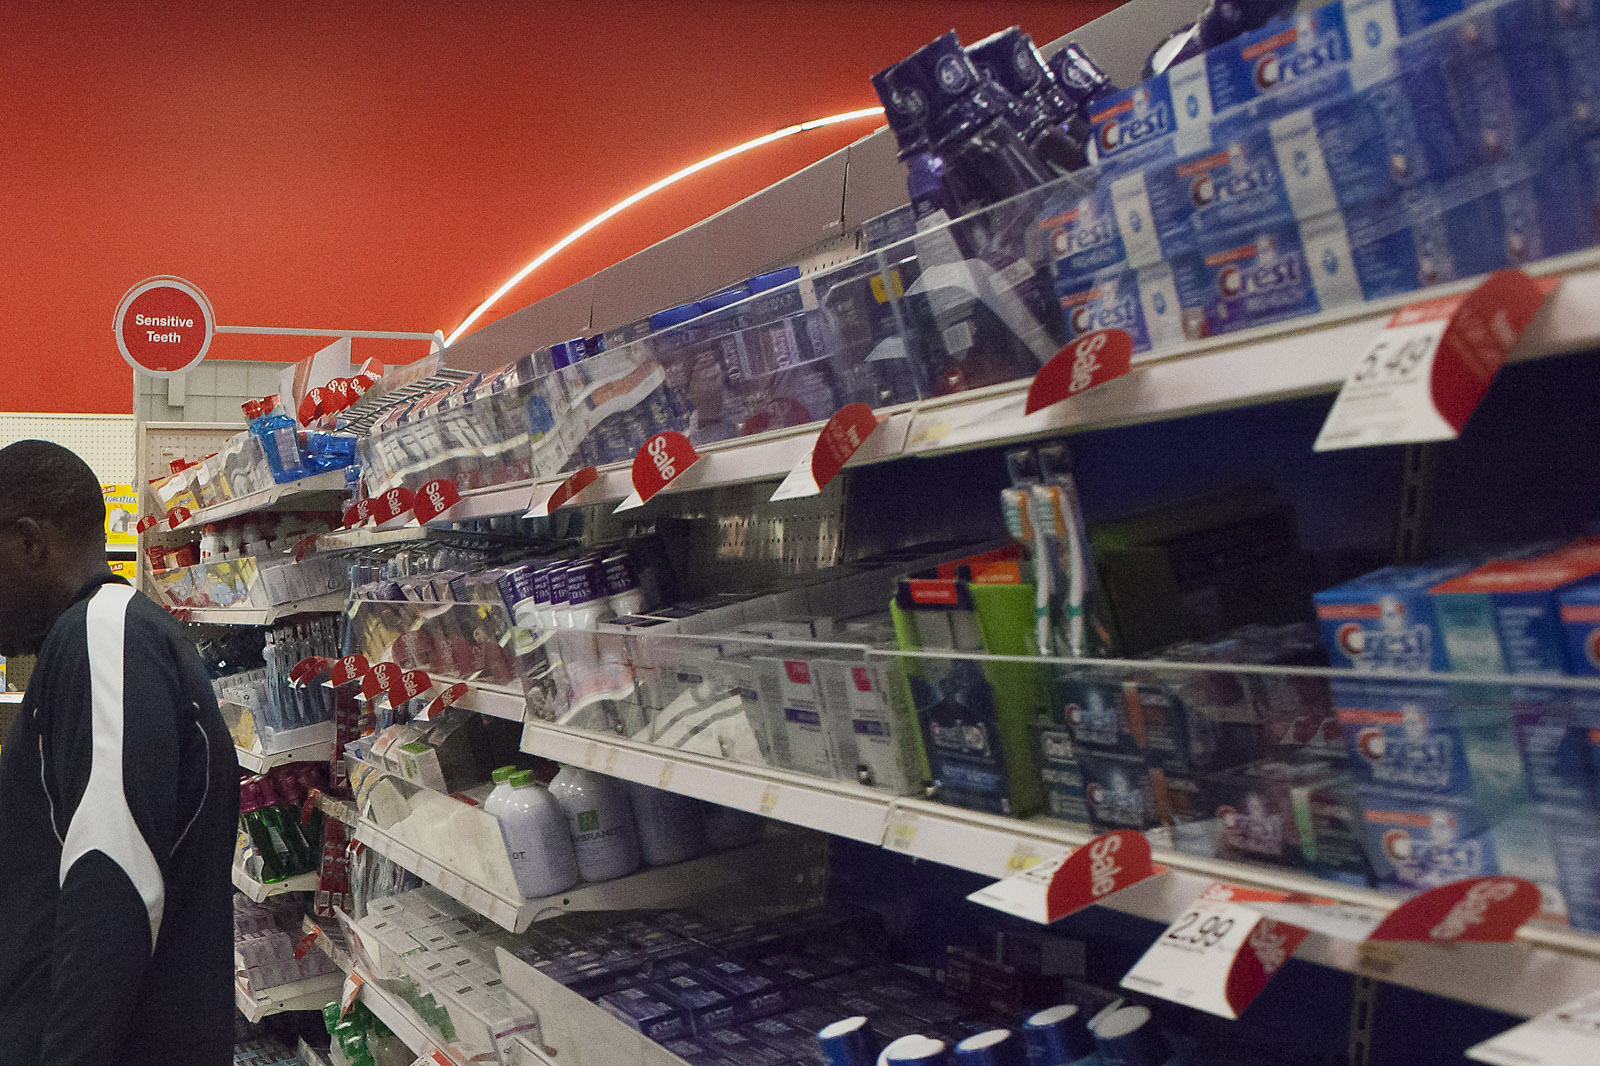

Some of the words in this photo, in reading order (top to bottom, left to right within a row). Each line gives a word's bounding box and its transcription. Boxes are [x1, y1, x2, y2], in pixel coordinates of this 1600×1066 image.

[1256, 33, 1342, 89] Crest
[1102, 107, 1167, 150] Crest
[135, 314, 194, 328] Sensitive
[146, 331, 182, 344] Teeth
[310, 388, 322, 405] Sal
[647, 436, 677, 481] Sale
[386, 488, 402, 516] Sale
[426, 481, 445, 512] Sale
[356, 500, 368, 520] Sale
[344, 656, 356, 679] Sale
[374, 664, 389, 689] Sale
[402, 672, 417, 697] Sale
